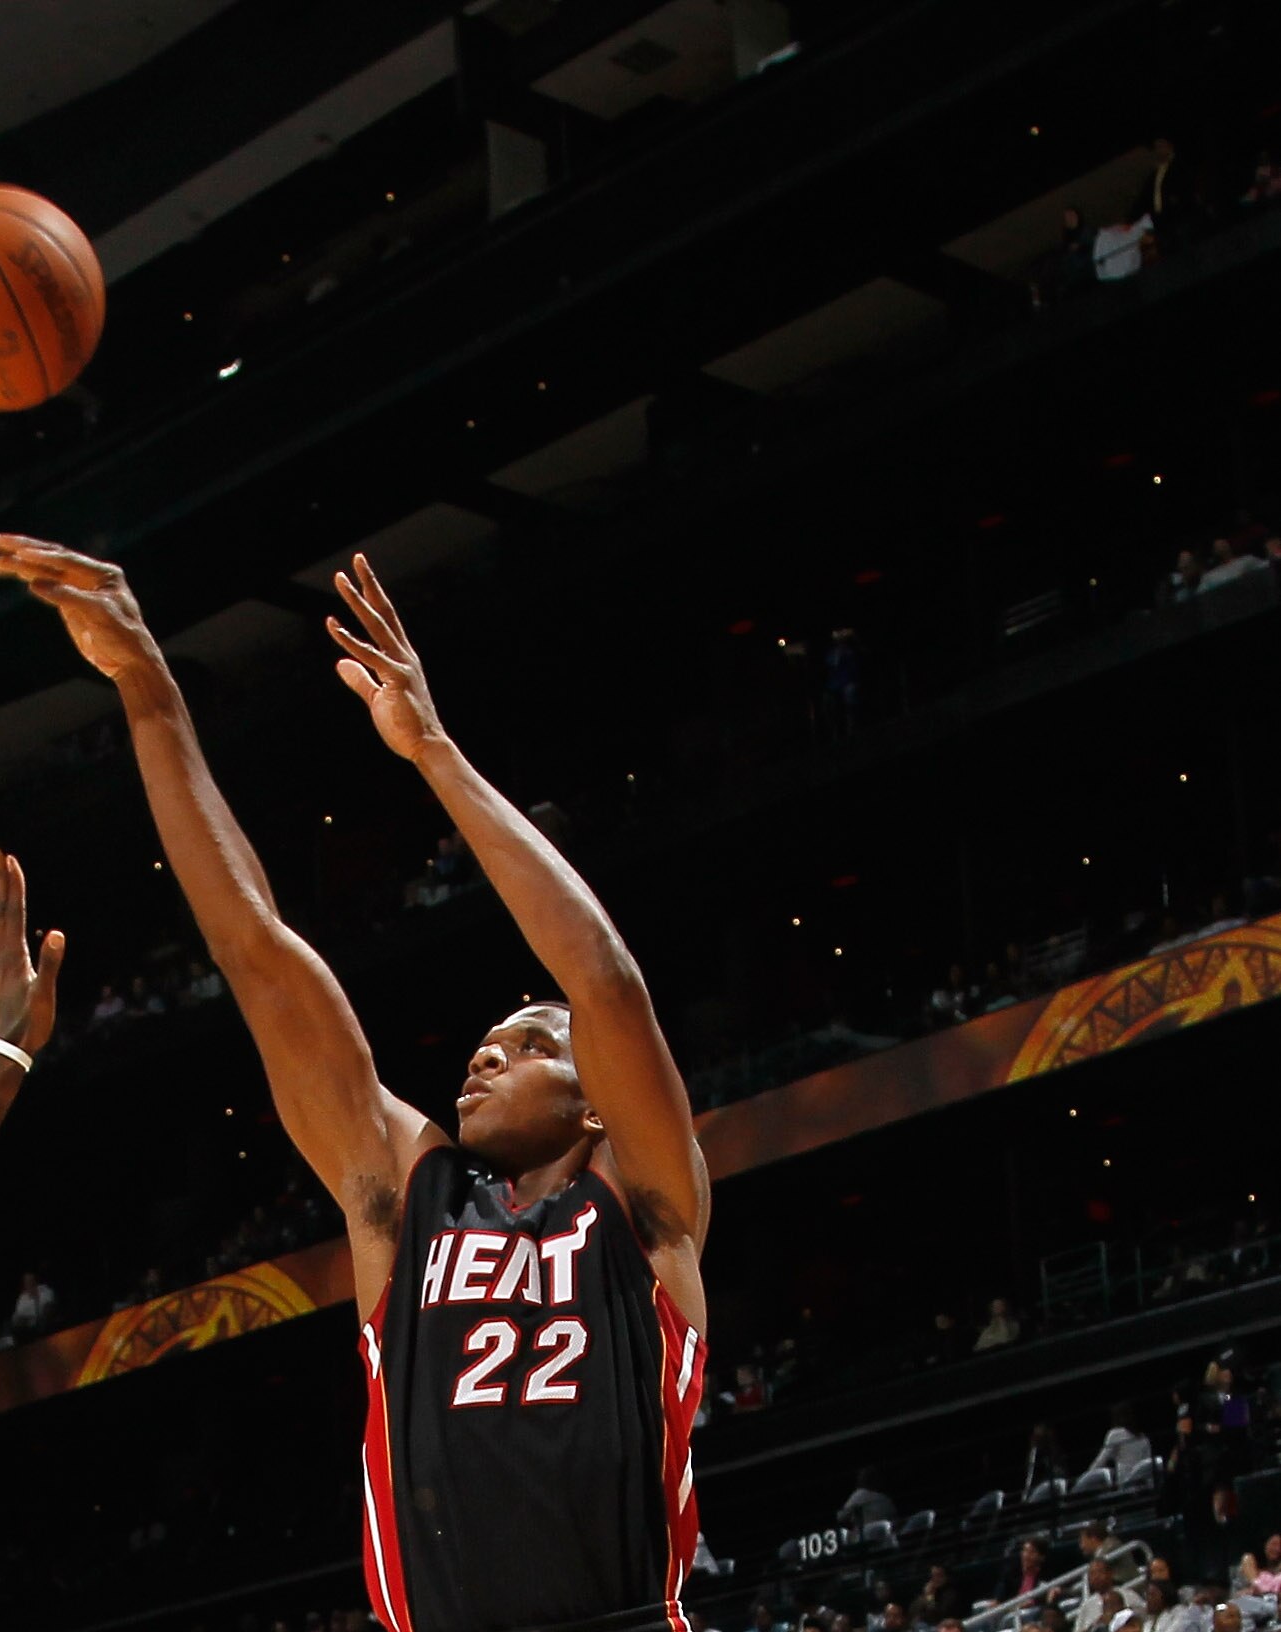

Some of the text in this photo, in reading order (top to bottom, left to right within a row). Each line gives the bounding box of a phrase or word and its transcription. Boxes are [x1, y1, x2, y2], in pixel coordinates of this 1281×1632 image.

[422, 1203, 598, 1309] HEAT
[450, 1317, 591, 1409] 22
[798, 1529, 838, 1560] 103
